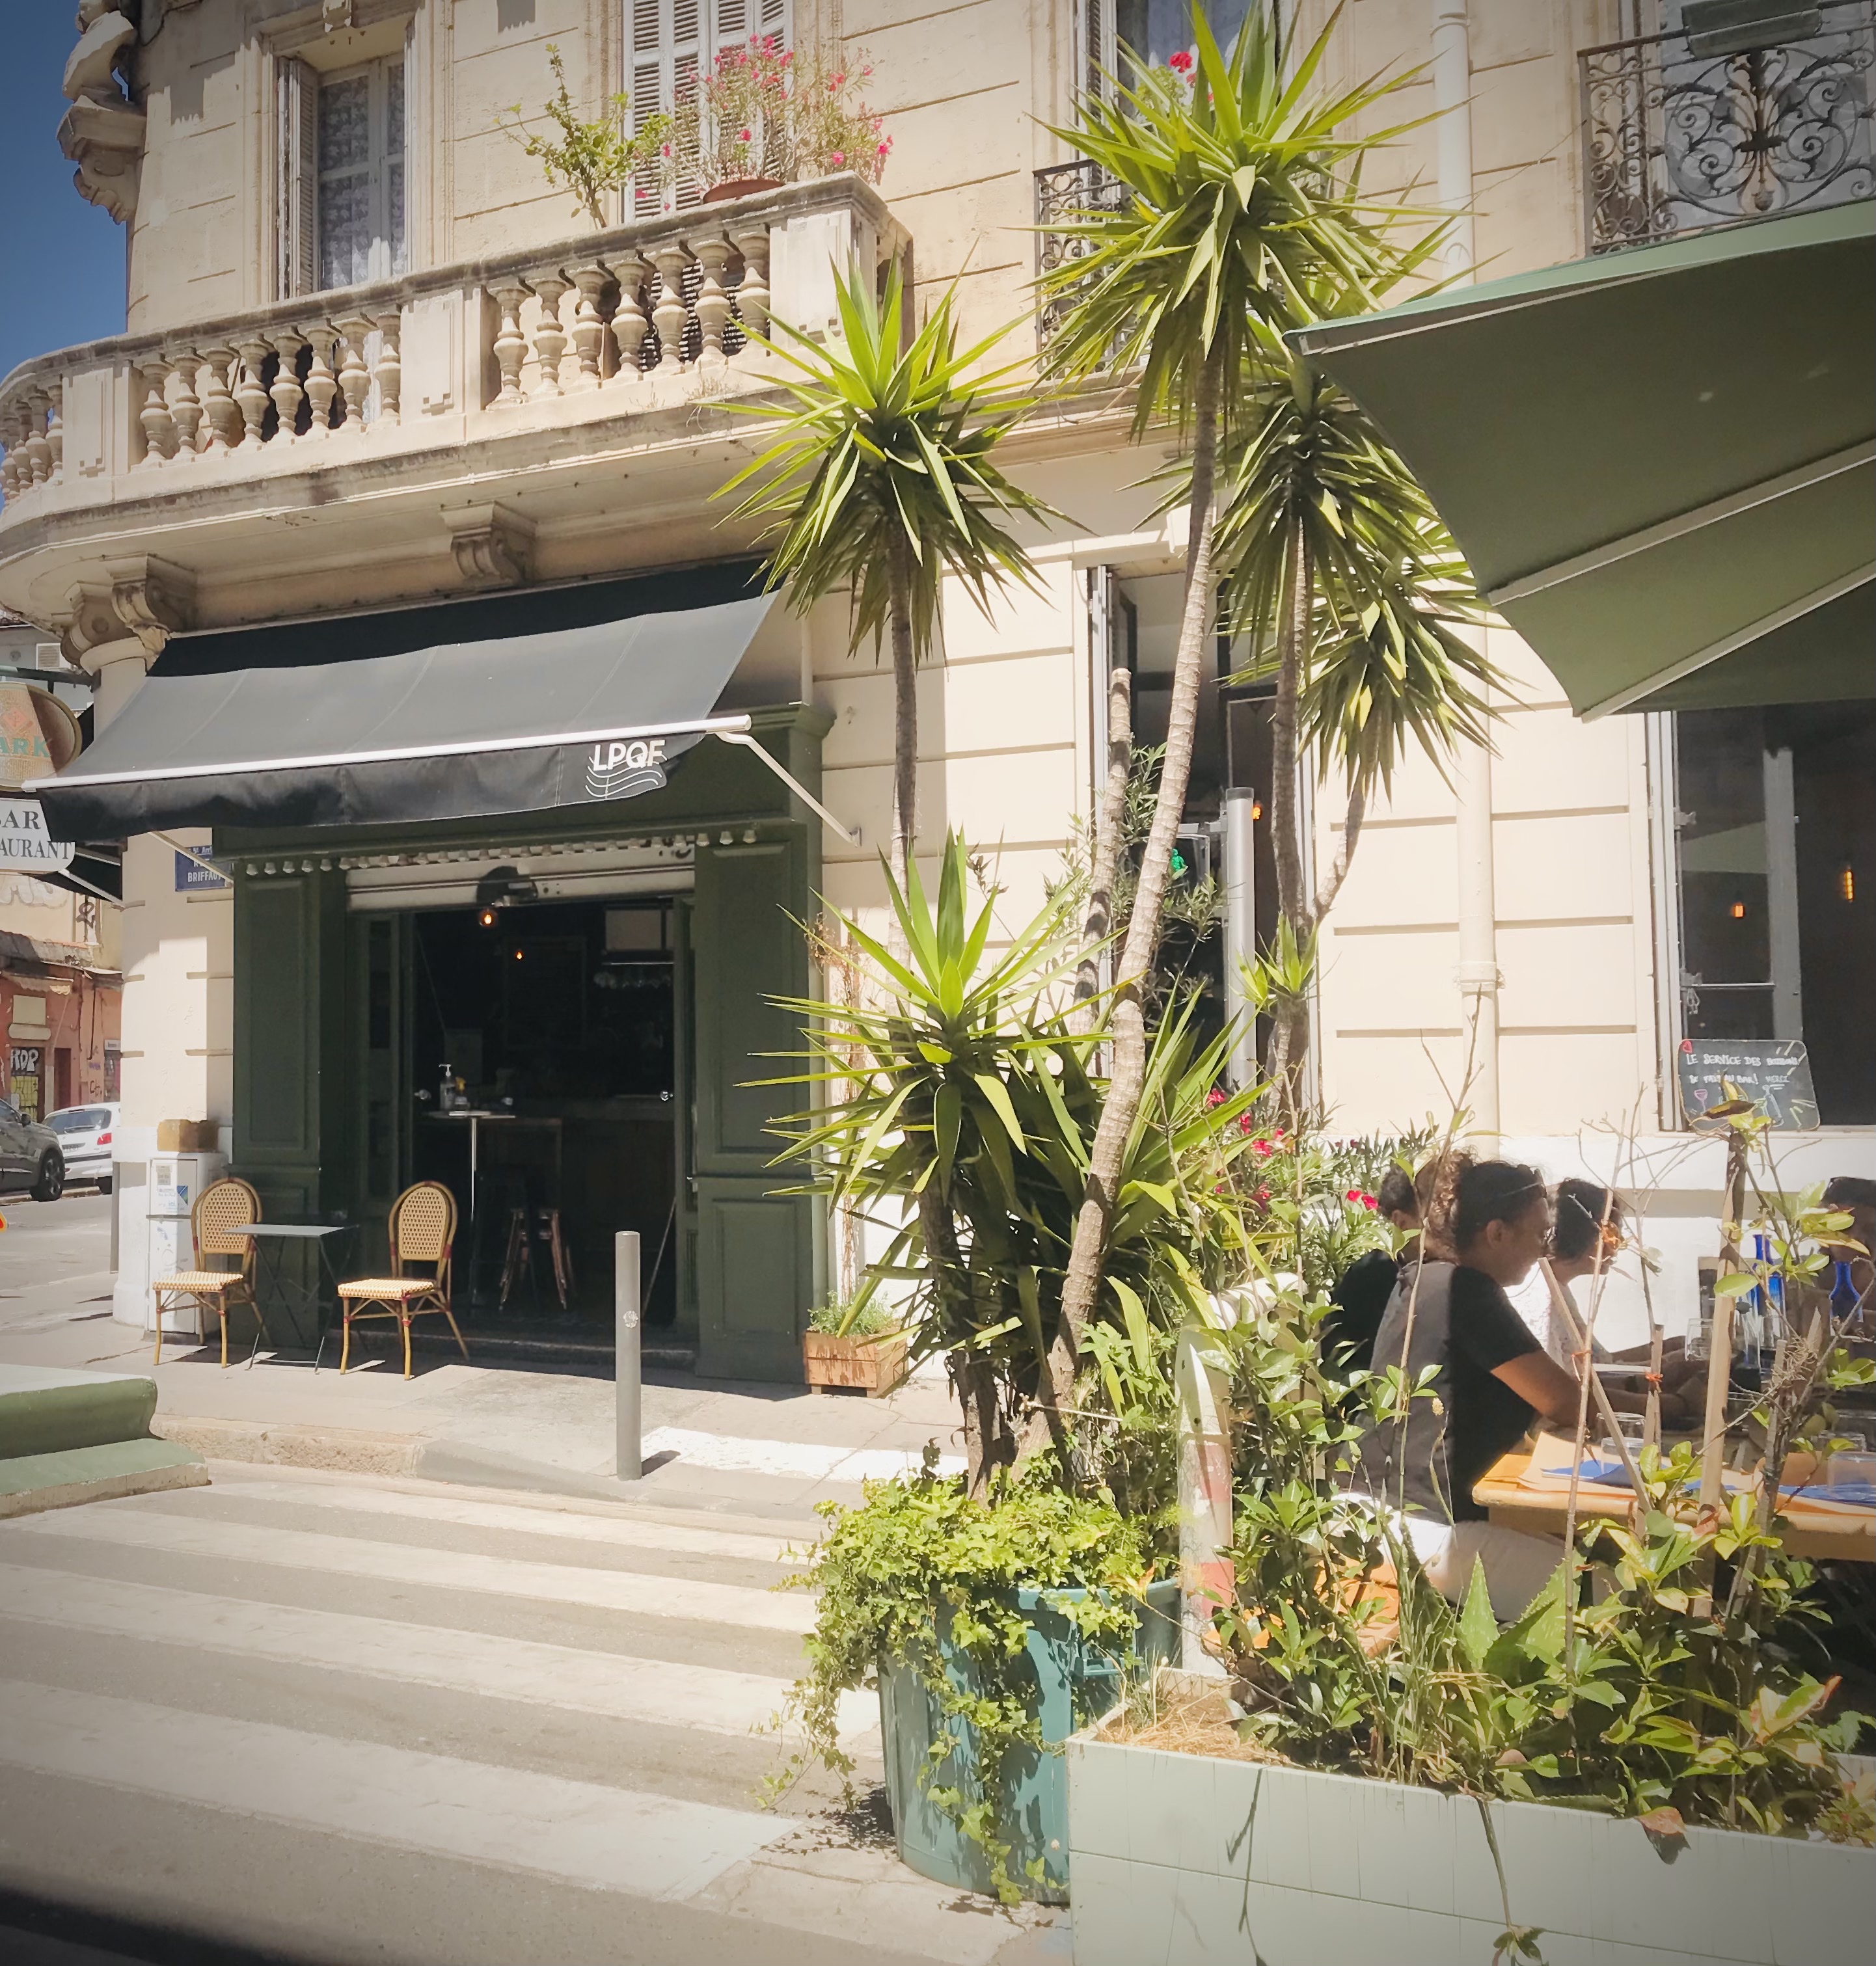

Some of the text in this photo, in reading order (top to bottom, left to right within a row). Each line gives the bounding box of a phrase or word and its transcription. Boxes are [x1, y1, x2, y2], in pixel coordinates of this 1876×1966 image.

[593, 739, 666, 771] LPQF
[0, 809, 42, 829] AR
[1686, 1053, 1699, 1065] LE
[1703, 1053, 1742, 1065] SERVICE
[1744, 1056, 1762, 1066] DES
